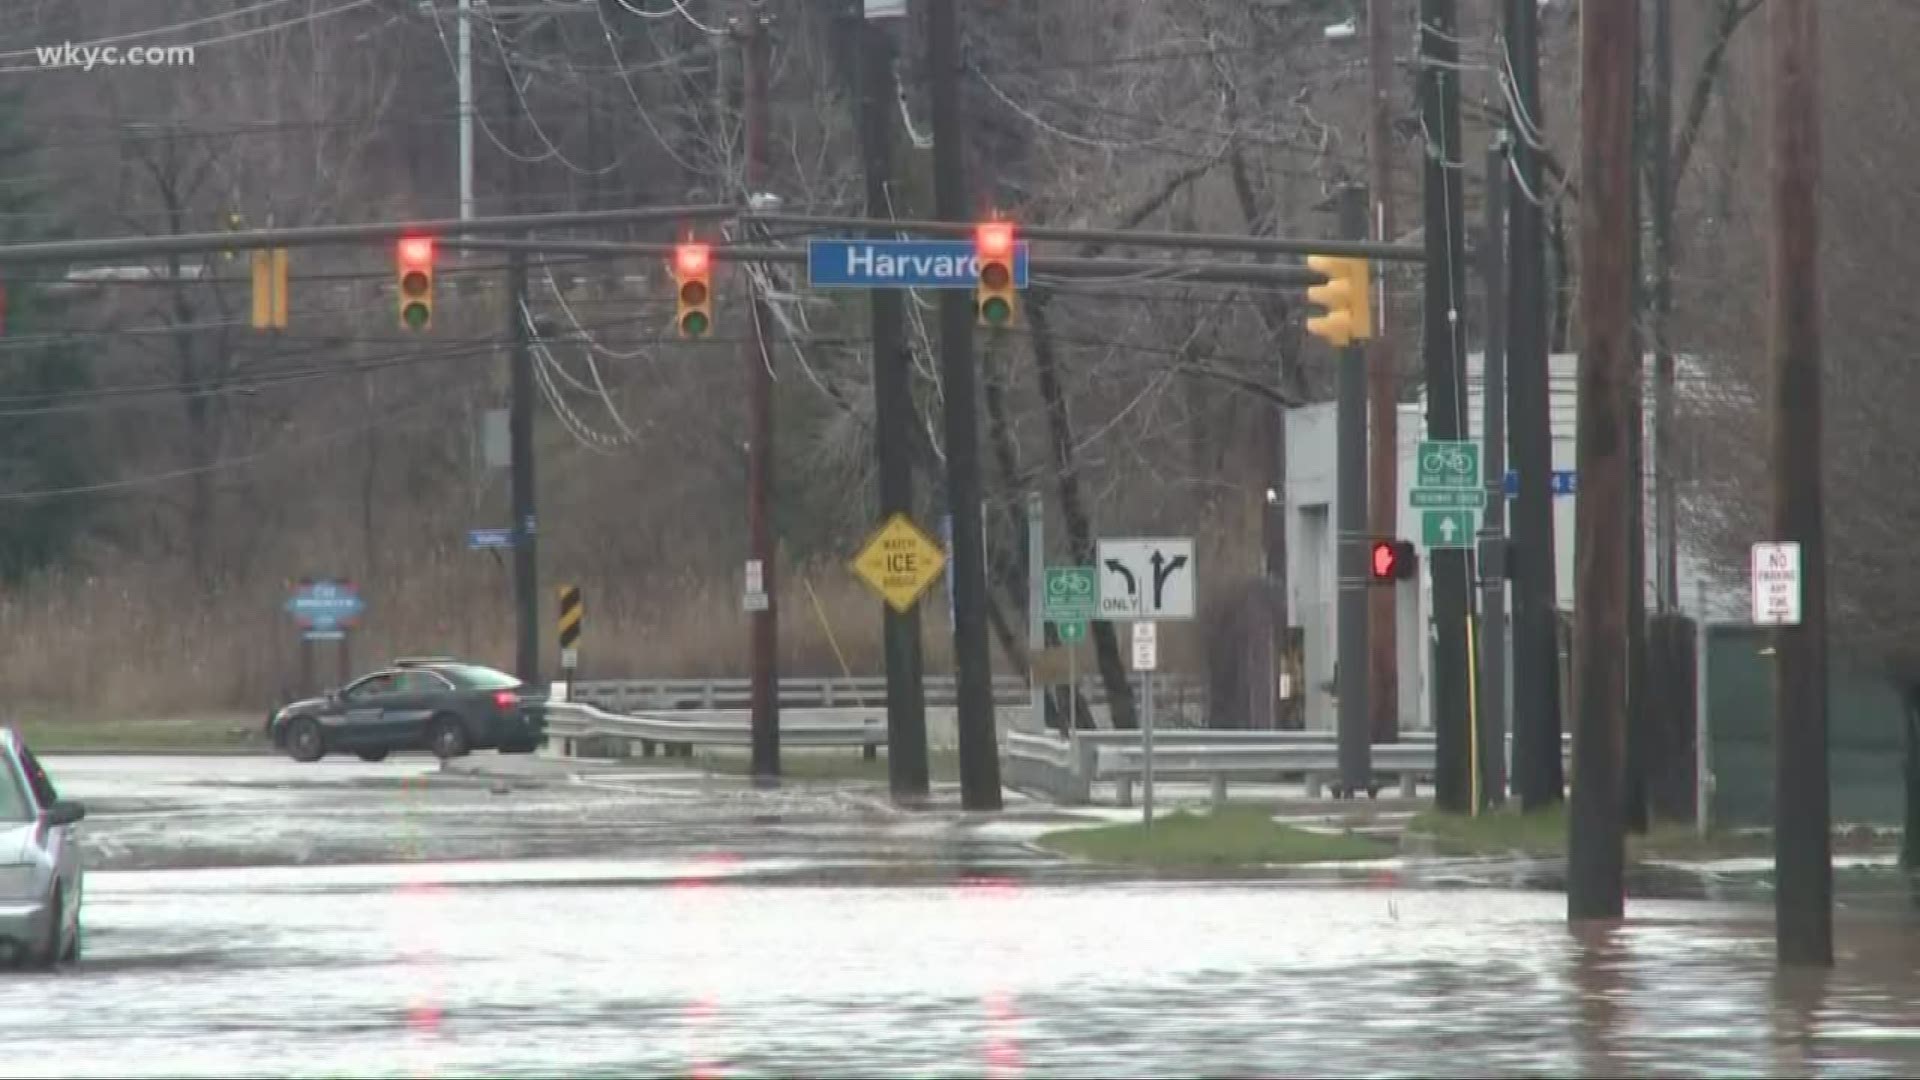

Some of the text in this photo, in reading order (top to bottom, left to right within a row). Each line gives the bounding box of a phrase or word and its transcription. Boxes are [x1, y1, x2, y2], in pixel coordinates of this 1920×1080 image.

[886, 552, 918, 572] ICE
[1769, 552, 1788, 568] NO
[1103, 597, 1138, 612] ONLY
